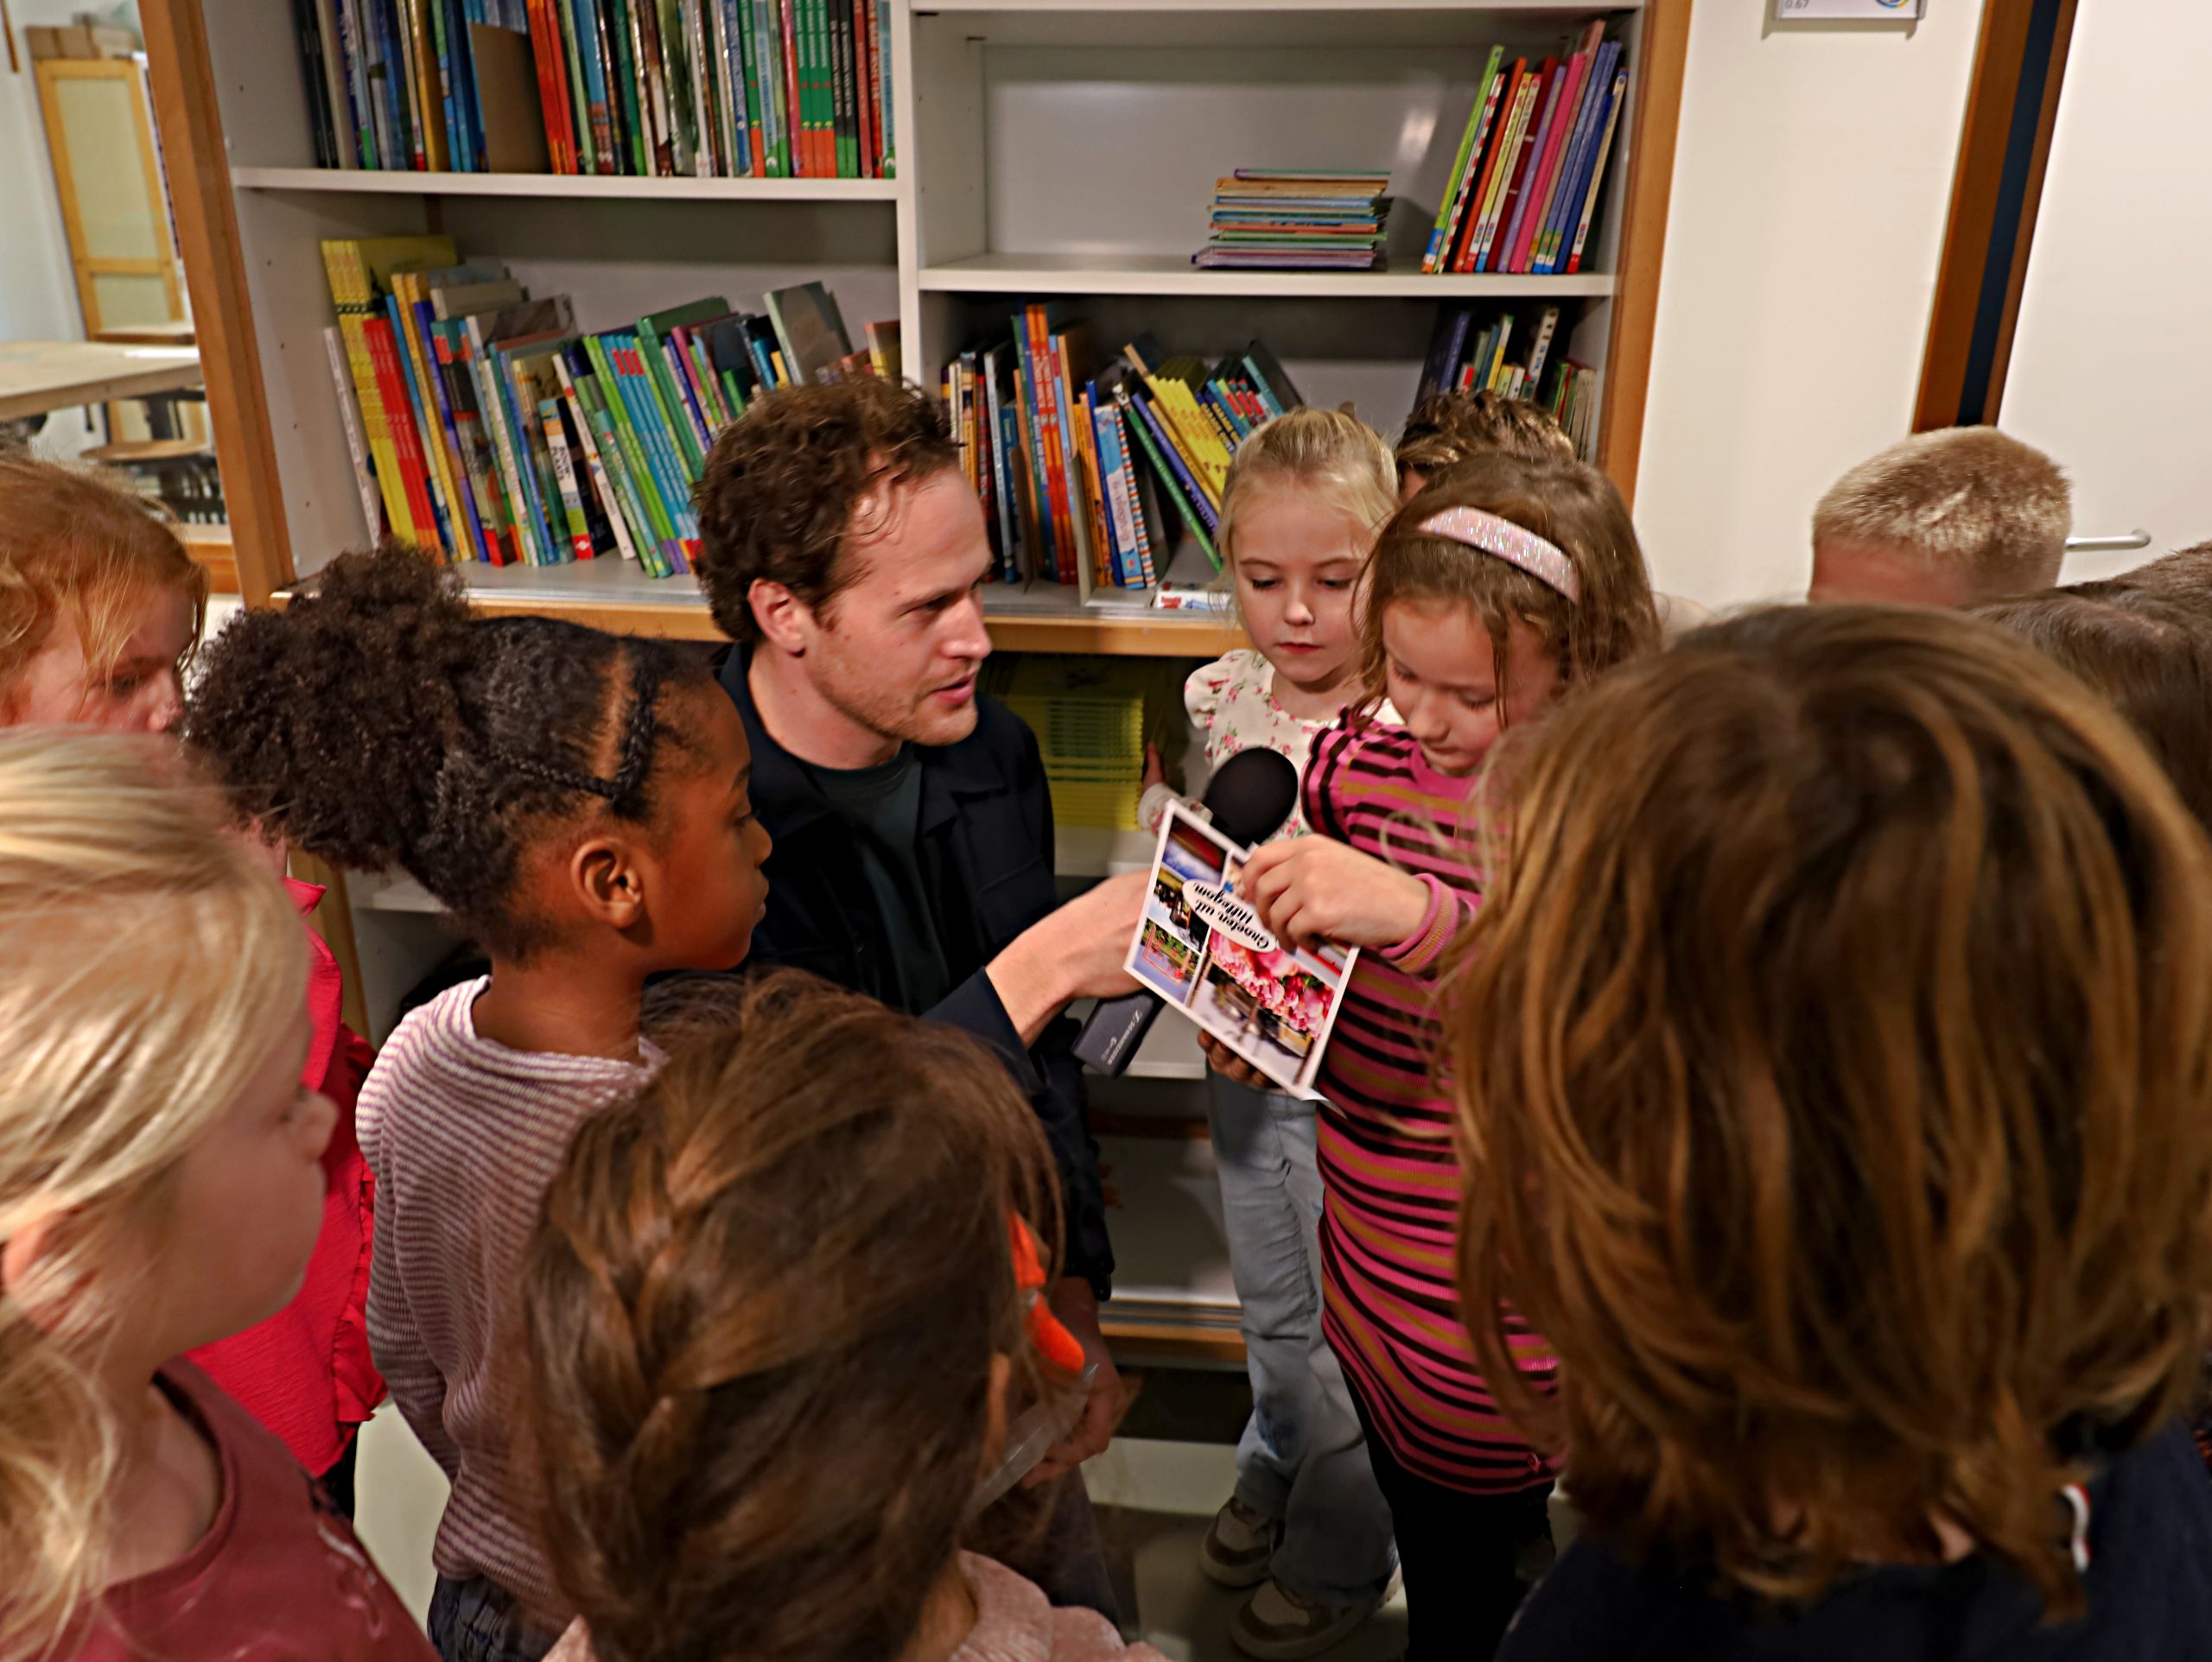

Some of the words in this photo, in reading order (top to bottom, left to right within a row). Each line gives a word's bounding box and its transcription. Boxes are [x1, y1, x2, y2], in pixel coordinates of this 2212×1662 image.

[1193, 882, 1254, 925] Hillegom
[1195, 898, 1215, 917] uit
[1217, 910, 1269, 949] Groeten
